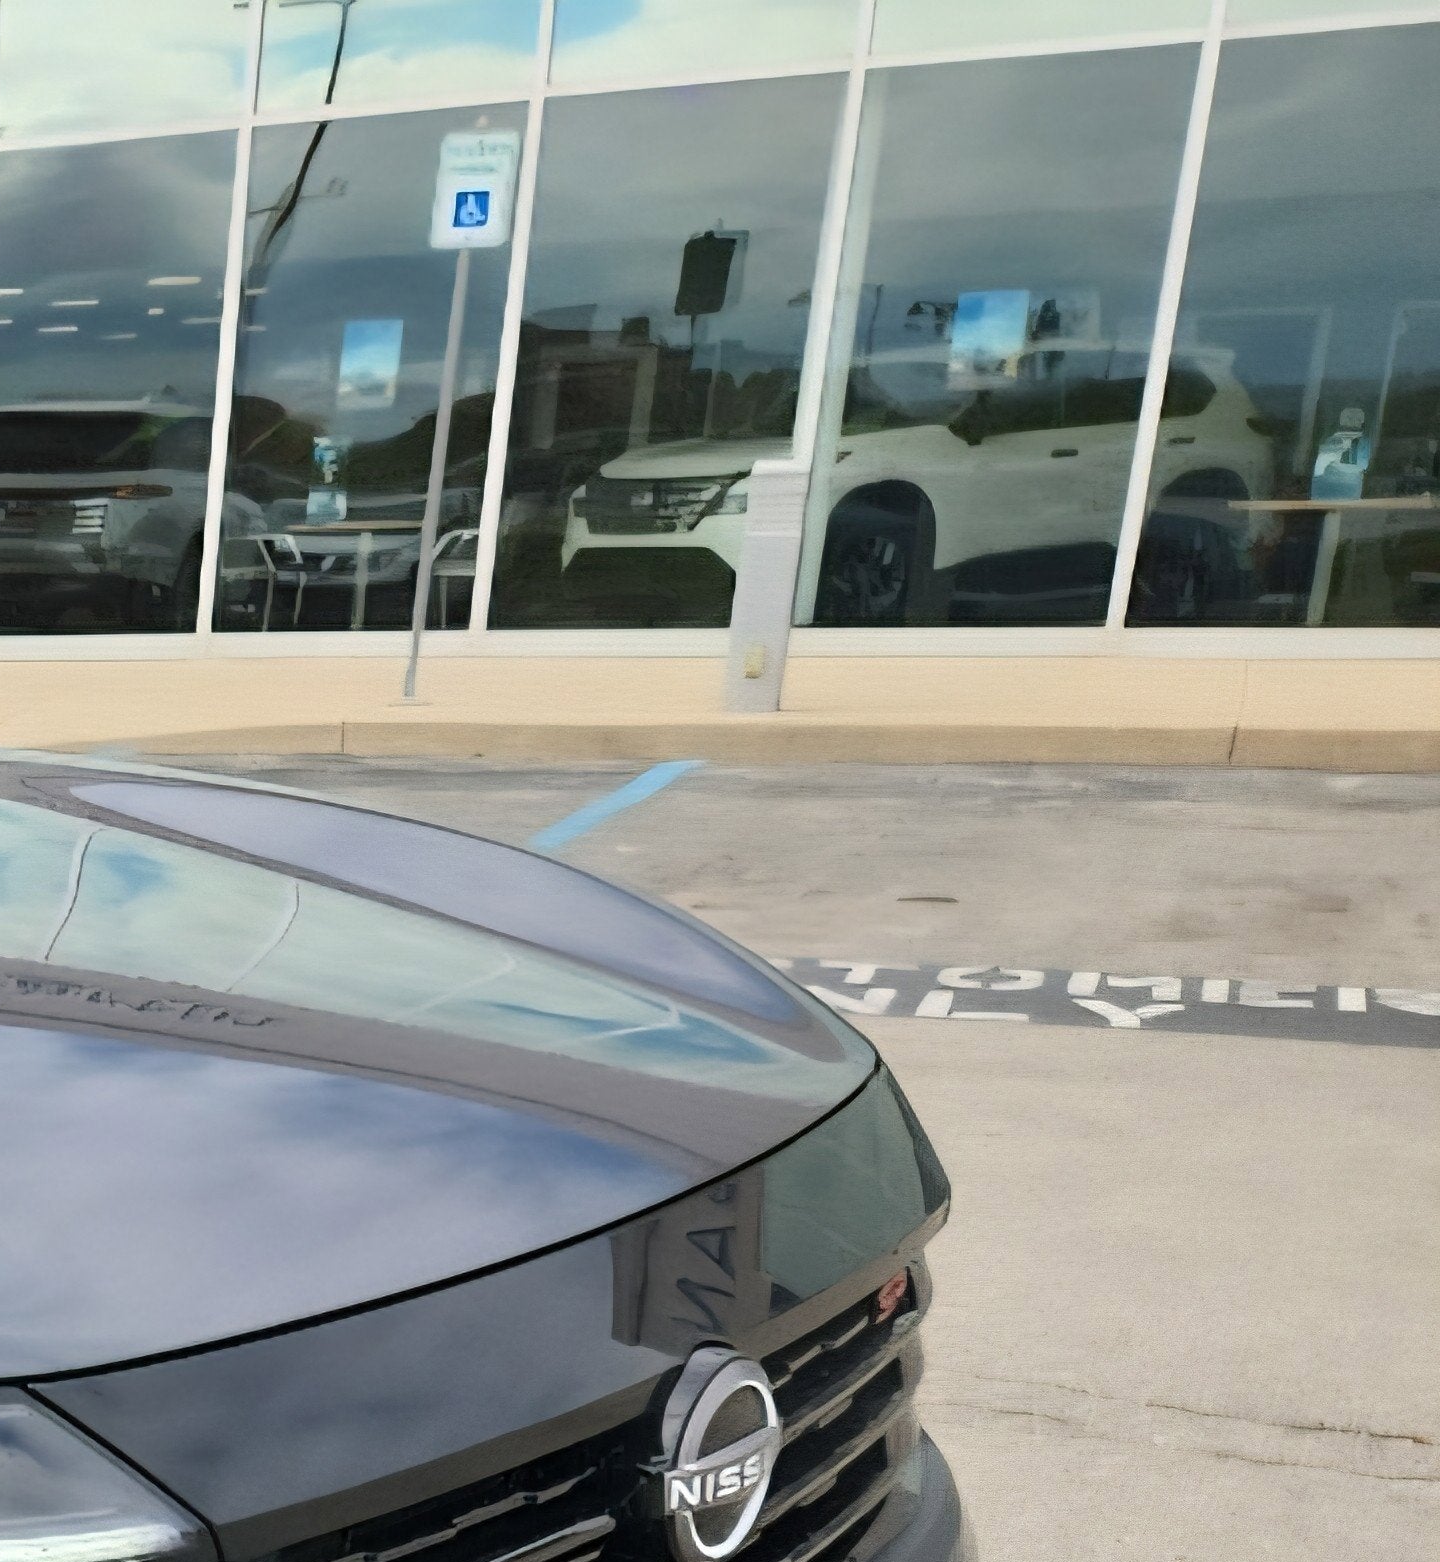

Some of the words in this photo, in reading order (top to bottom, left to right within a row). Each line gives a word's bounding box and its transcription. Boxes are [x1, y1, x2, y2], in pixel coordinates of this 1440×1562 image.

[765, 956, 1440, 1016] TOMER
[806, 984, 1187, 1029] NLY
[670, 1453, 762, 1510] NISS
